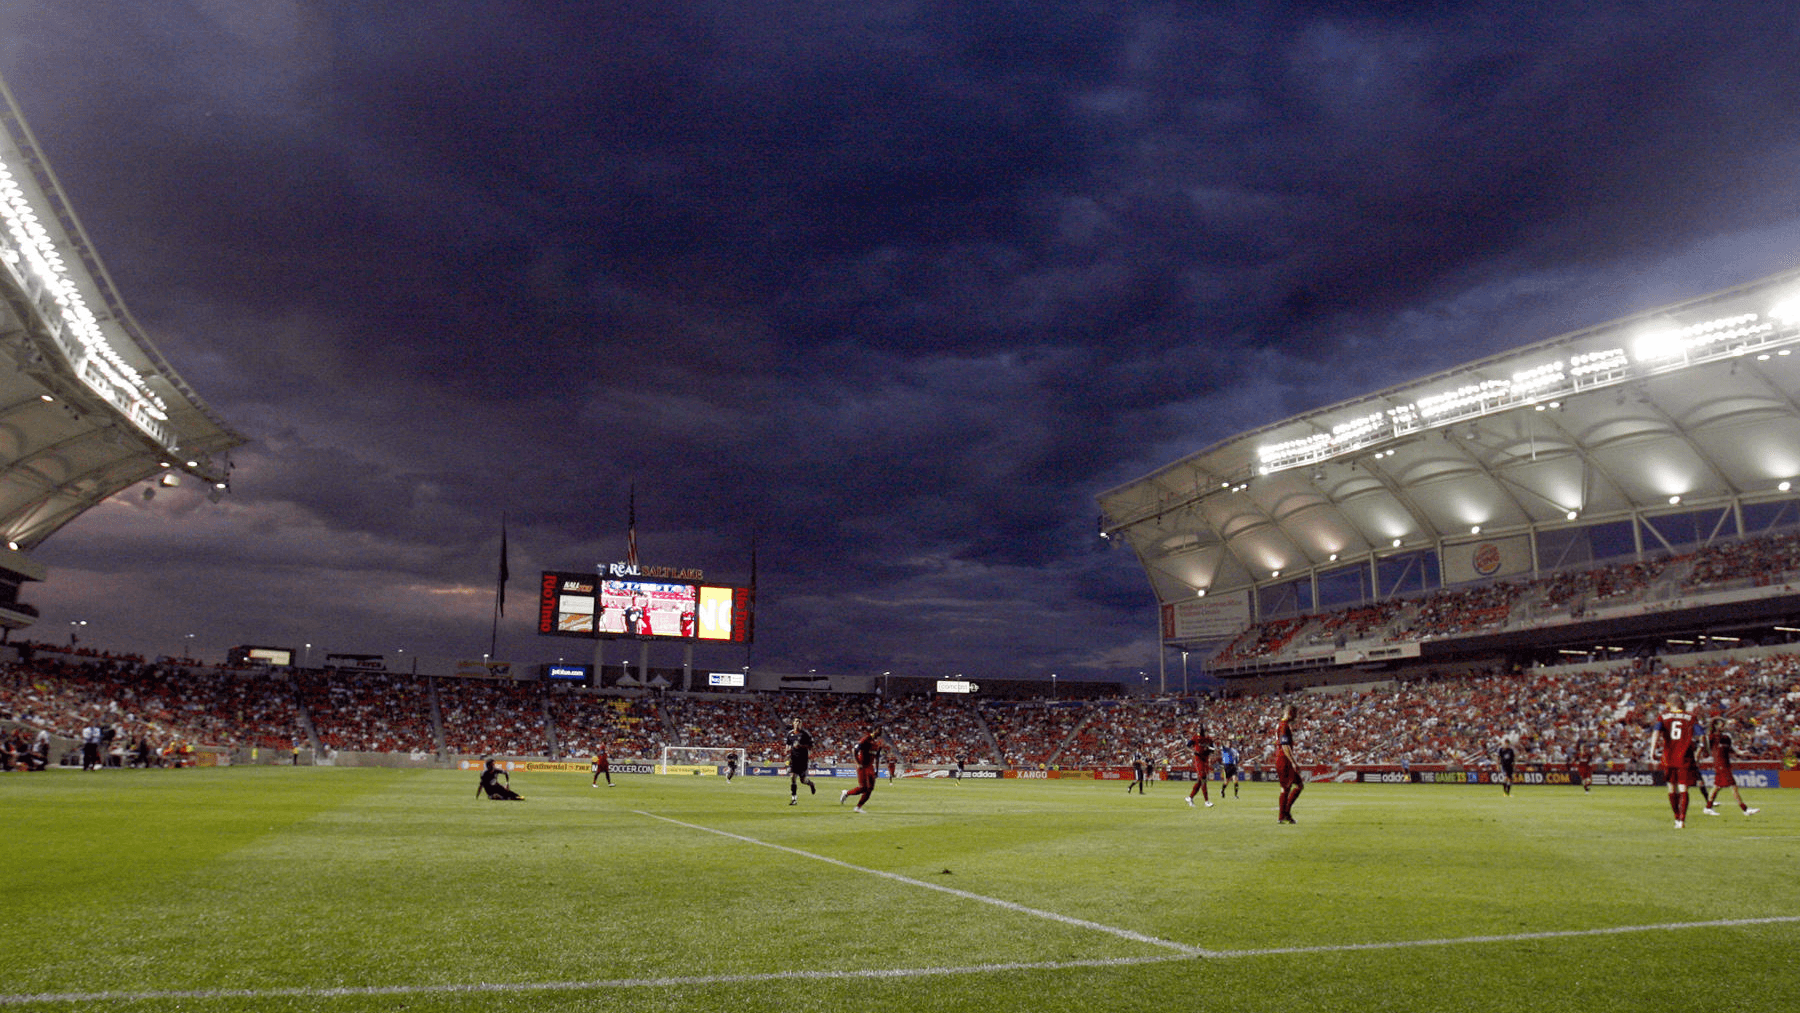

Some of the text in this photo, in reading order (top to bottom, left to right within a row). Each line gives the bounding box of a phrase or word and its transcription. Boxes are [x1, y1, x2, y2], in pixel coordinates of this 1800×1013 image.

[671, 567, 704, 580] LAKE
[1671, 721, 1682, 740] 6
[1017, 771, 1048, 779] XANGO
[1421, 772, 1434, 782] THE
[1608, 772, 1654, 785] adidas
